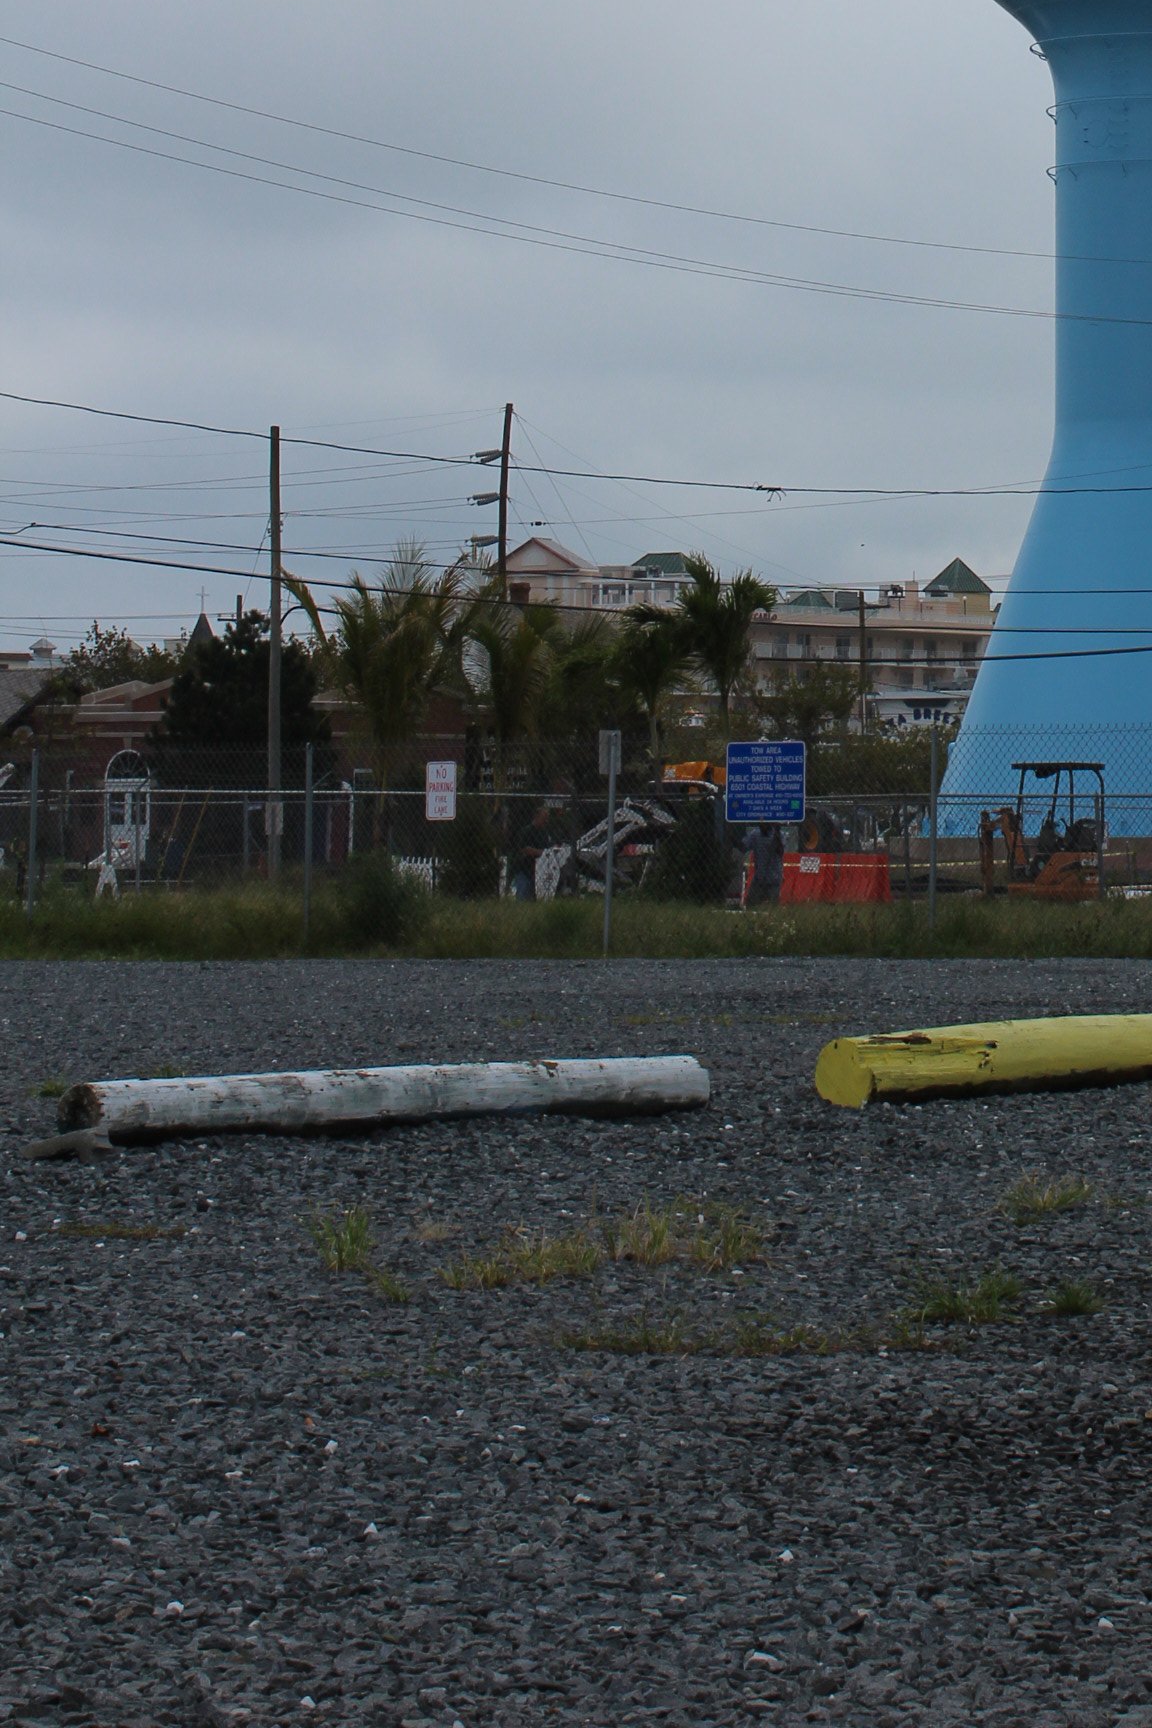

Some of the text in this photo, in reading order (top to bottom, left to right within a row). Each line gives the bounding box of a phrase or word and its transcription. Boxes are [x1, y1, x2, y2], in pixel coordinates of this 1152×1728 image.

[766, 746, 782, 754] AREA
[729, 755, 803, 764] UNAUTHORIZED VEHICLES
[435, 768, 447, 779] NO
[751, 765, 781, 773] TOWED TO
[729, 774, 803, 783] PUBLIC SAFETY BUILDING
[429, 782, 454, 793] PARKING
[747, 783, 773, 791] COASTAL
[775, 783, 800, 791] HIGHWAY
